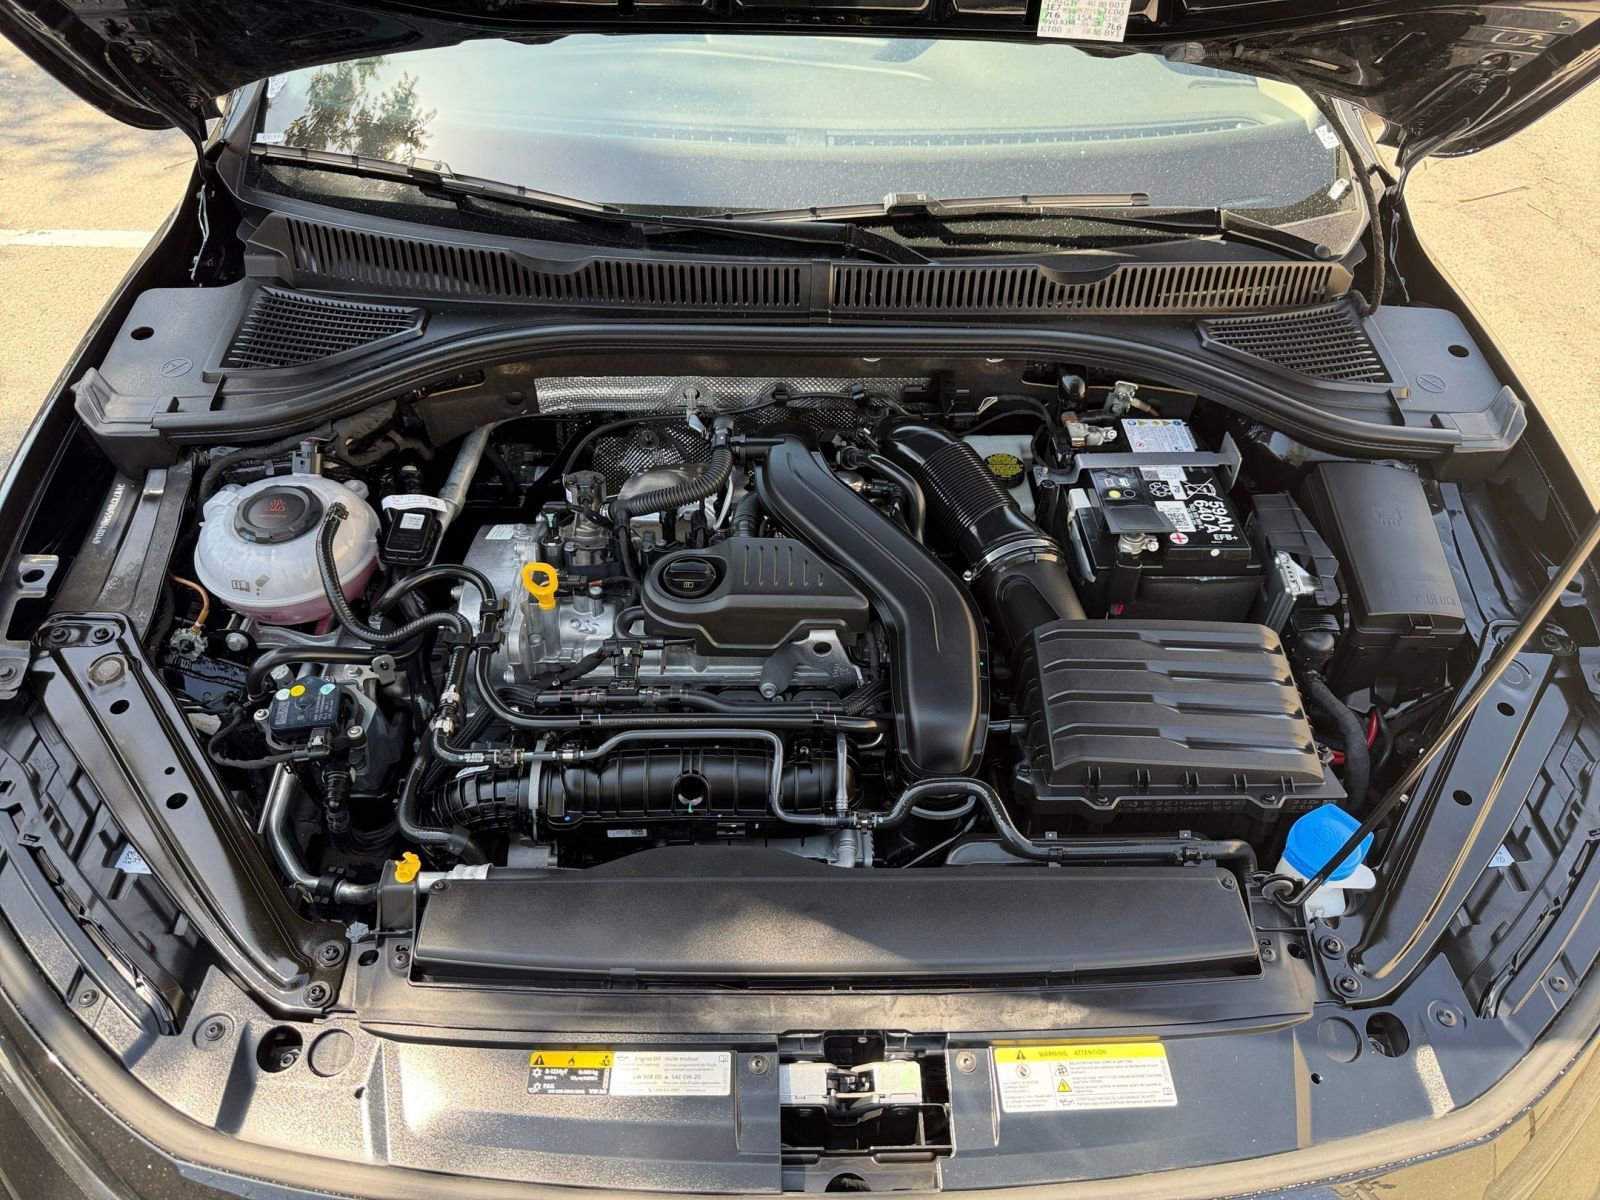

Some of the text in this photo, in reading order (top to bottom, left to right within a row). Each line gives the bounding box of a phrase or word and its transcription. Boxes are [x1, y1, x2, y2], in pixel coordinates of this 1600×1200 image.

[1193, 500, 1216, 521] 640
[1208, 501, 1235, 532] 59Ah
[1203, 523, 1221, 534] A
